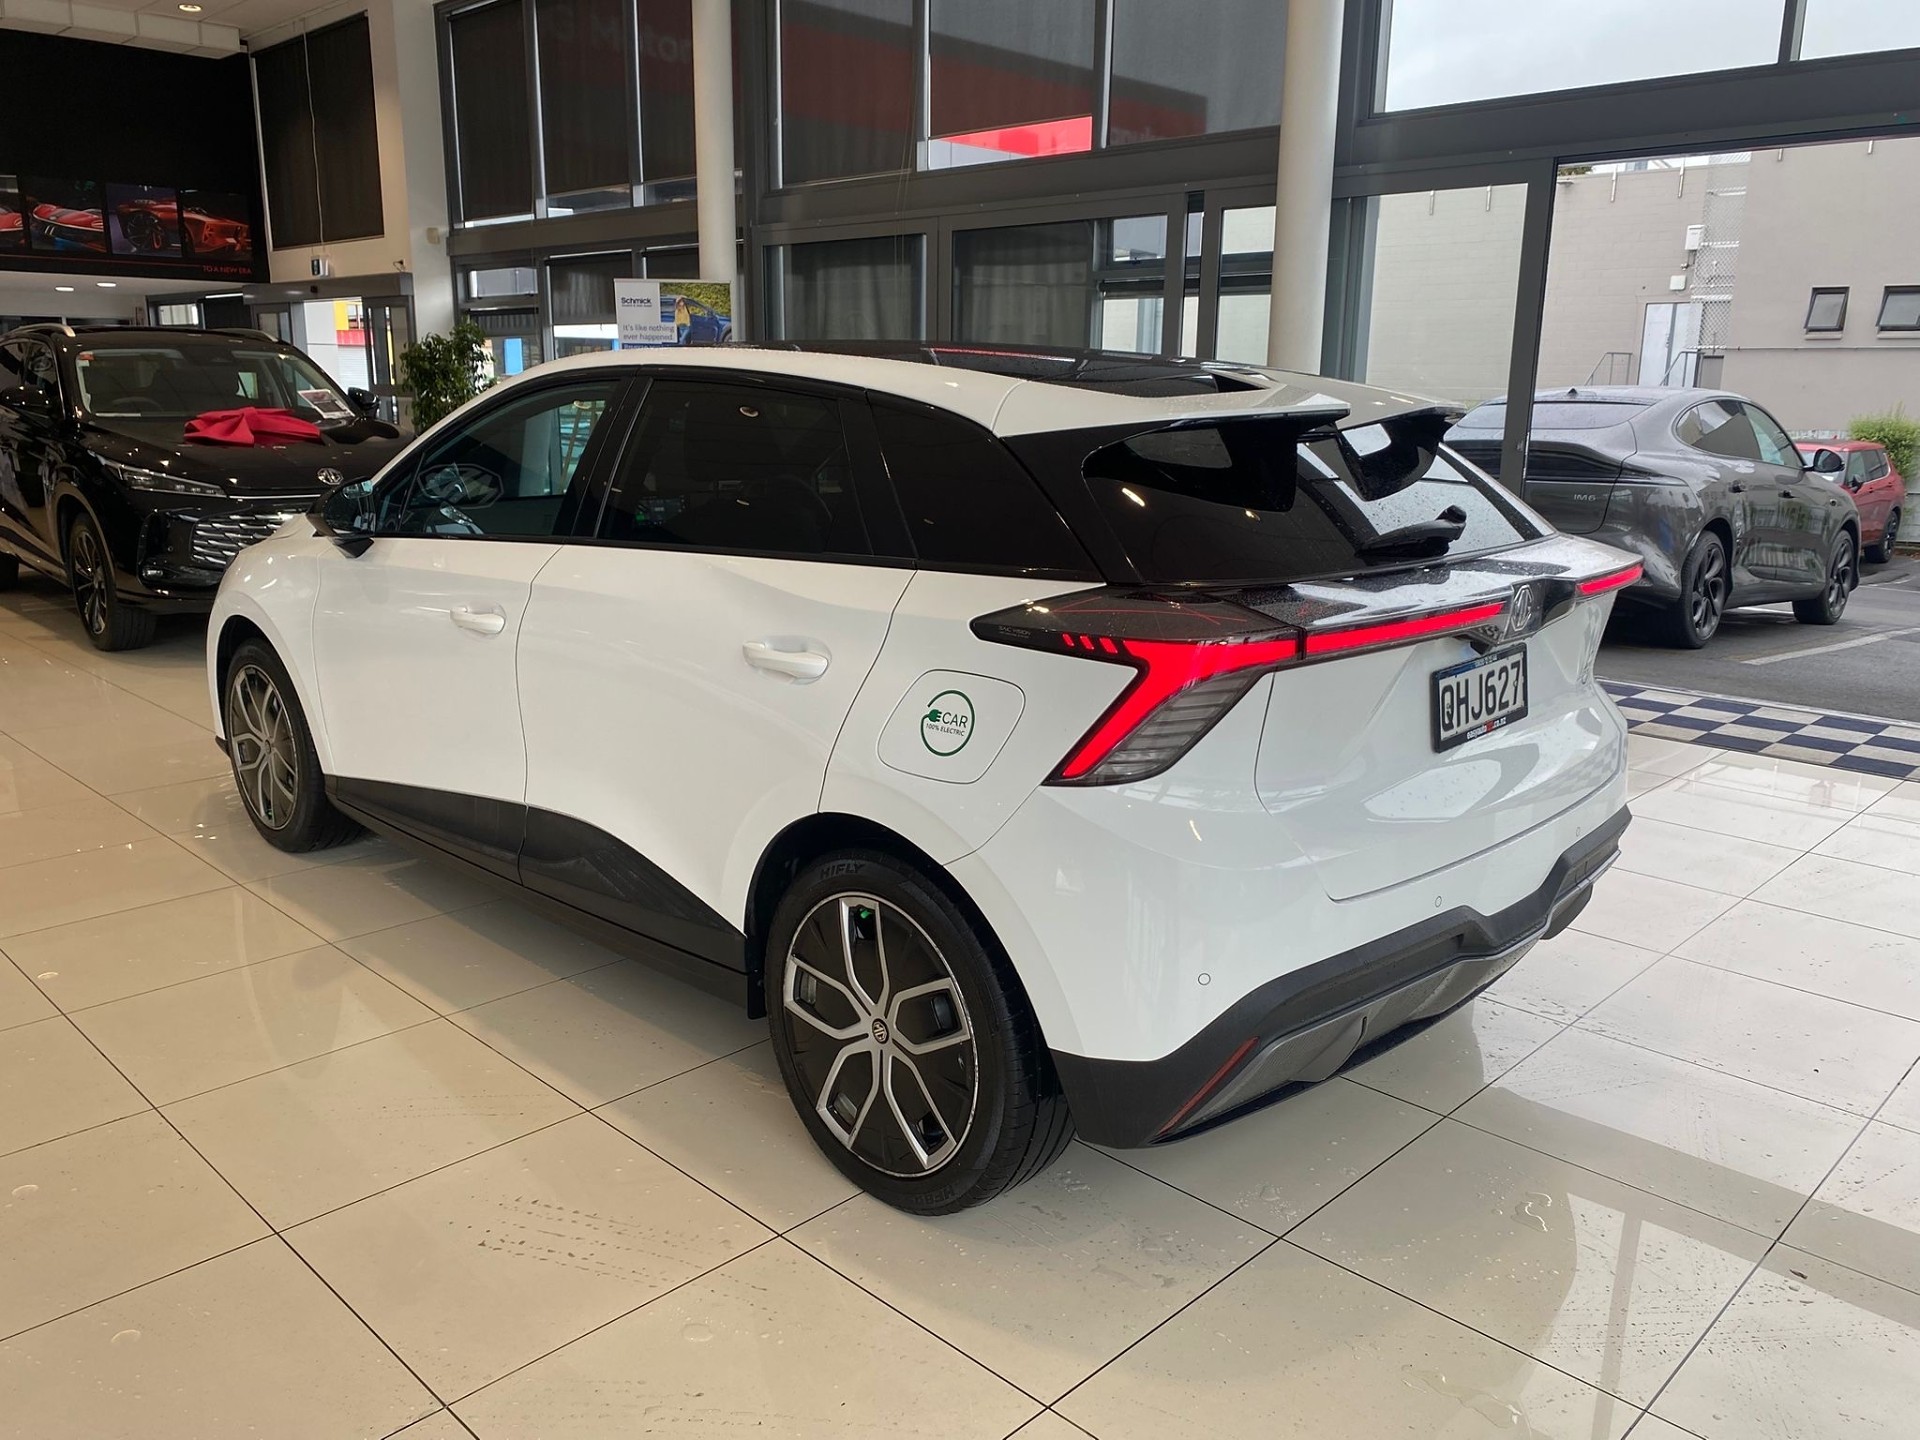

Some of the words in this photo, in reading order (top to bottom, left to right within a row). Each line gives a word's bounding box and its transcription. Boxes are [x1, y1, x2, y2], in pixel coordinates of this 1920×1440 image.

[621, 297, 651, 305] Schmick
[648, 325, 675, 333] nothing
[1573, 493, 1597, 502] IM6
[1441, 660, 1521, 732] QHJ627
[926, 723, 940, 731] 100%
[940, 726, 965, 736] ELECTRIC
